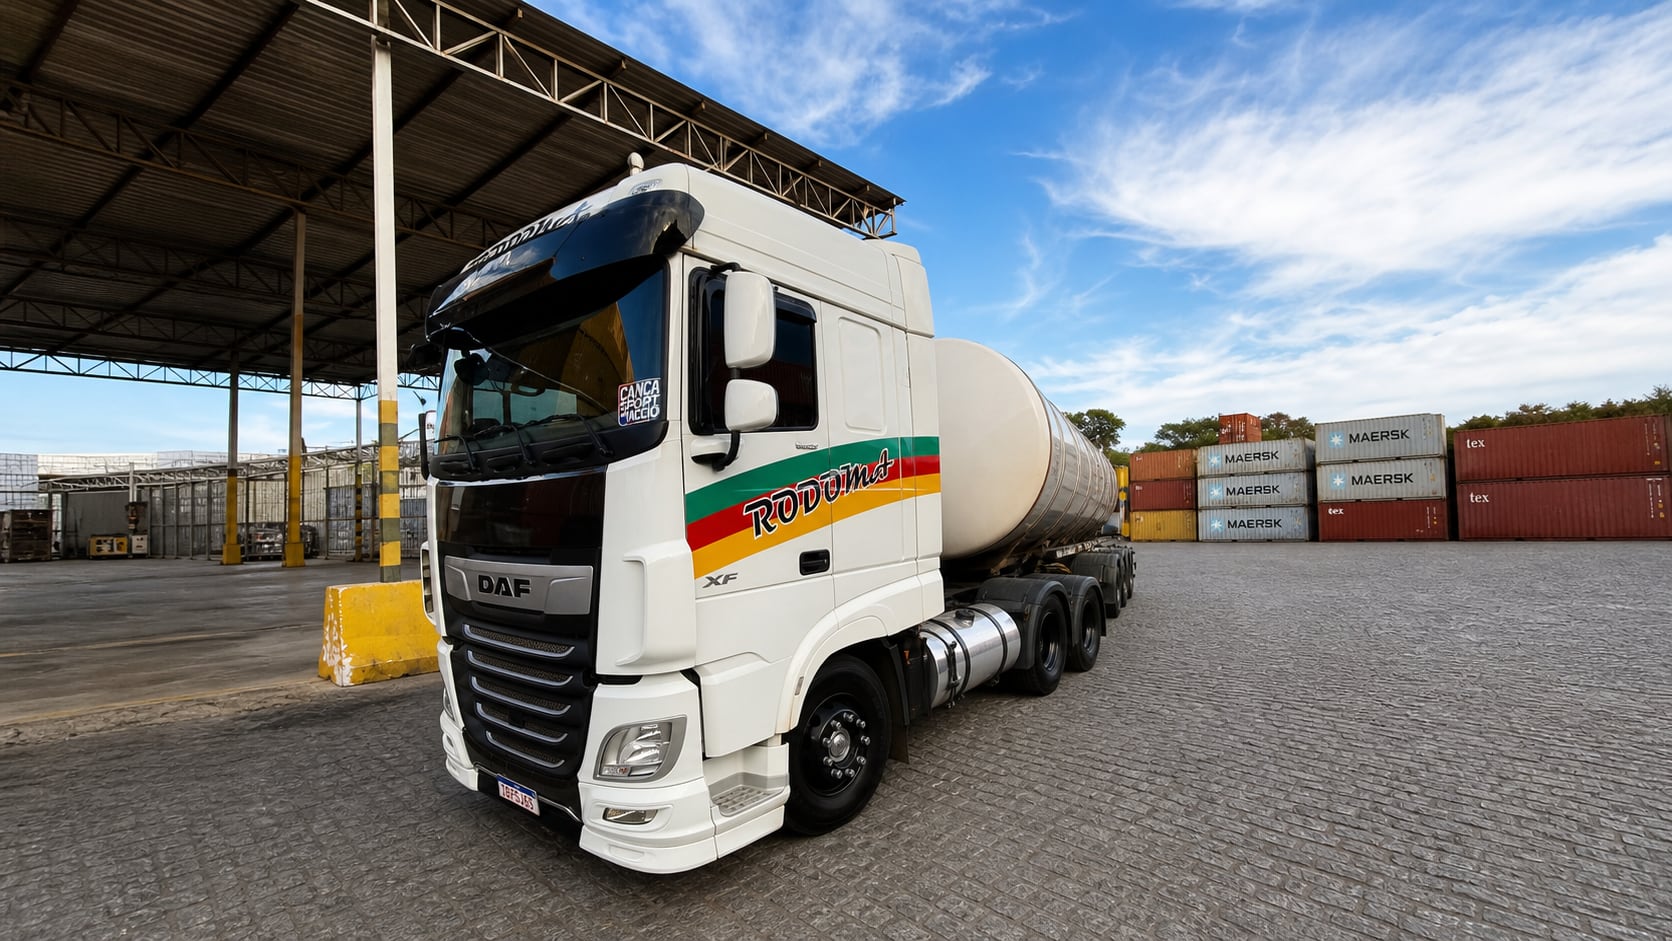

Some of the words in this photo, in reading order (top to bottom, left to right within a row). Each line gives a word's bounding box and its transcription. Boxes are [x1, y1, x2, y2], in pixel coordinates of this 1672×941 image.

[1349, 429, 1411, 445] MAERSK
[1466, 438, 1486, 449] tex
[1224, 450, 1280, 464] MAERSK
[1351, 472, 1414, 486] MAERSK
[1226, 485, 1281, 497] MAERSK
[1469, 491, 1490, 504] tex
[1327, 507, 1345, 516] tex
[1227, 518, 1283, 530] MAERSK
[478, 574, 532, 599] DAF
[702, 572, 739, 589] XF
